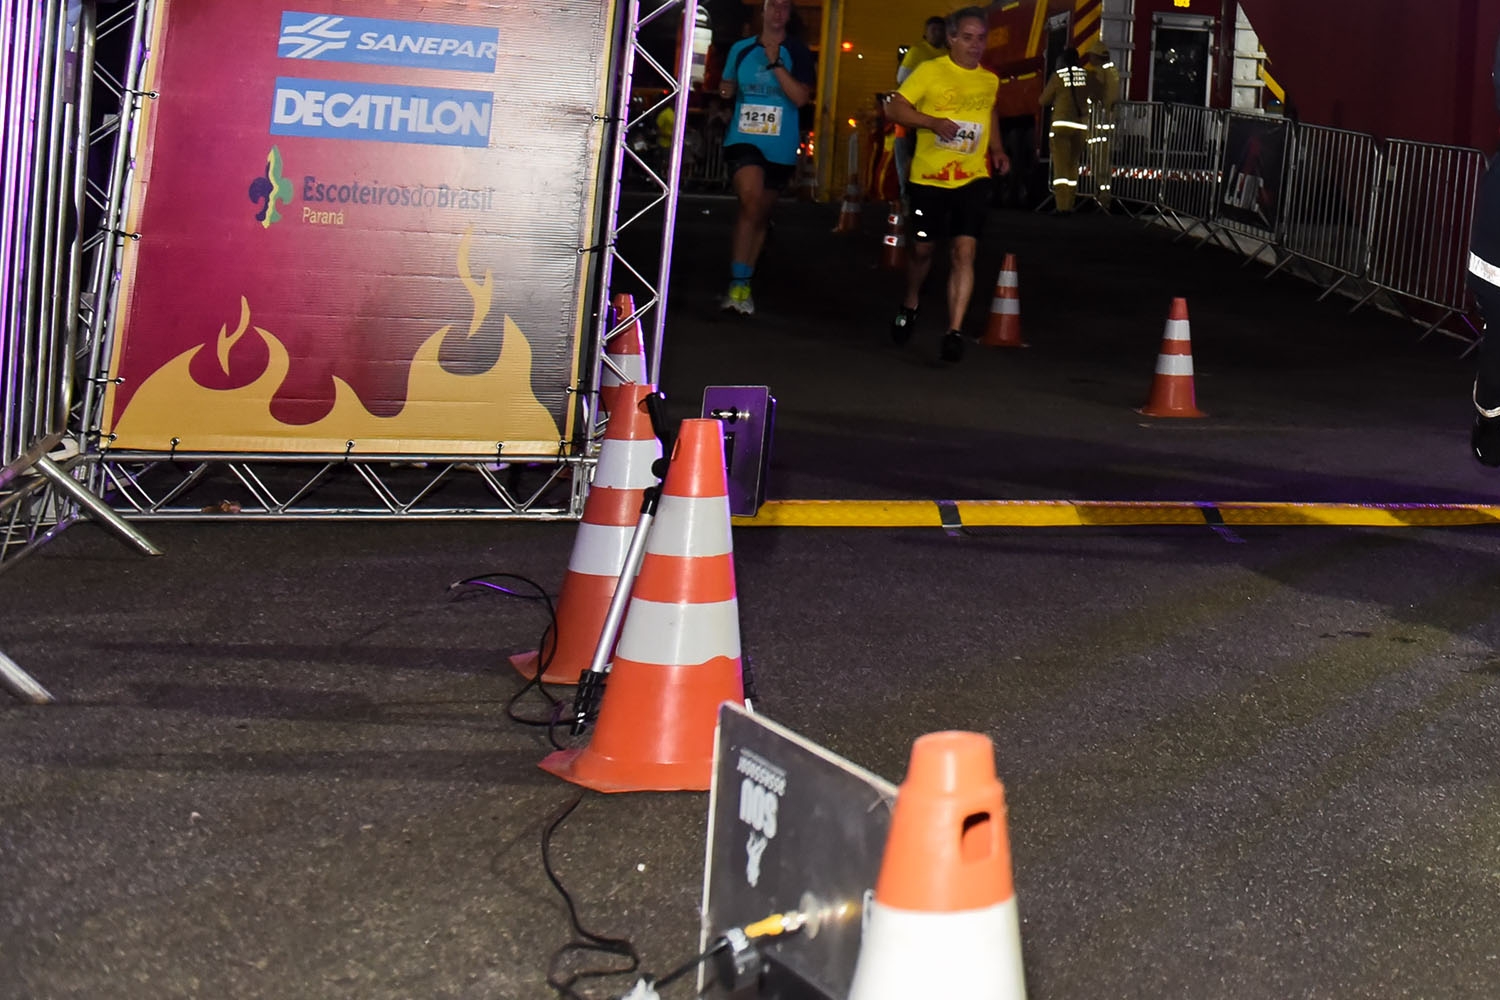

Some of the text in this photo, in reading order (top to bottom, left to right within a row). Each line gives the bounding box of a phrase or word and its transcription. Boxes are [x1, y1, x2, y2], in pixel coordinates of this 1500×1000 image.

[356, 32, 497, 60] SANEPAR
[273, 88, 489, 138] DECATHLON
[744, 111, 776, 123] 1216
[302, 207, 344, 225] Paraná
